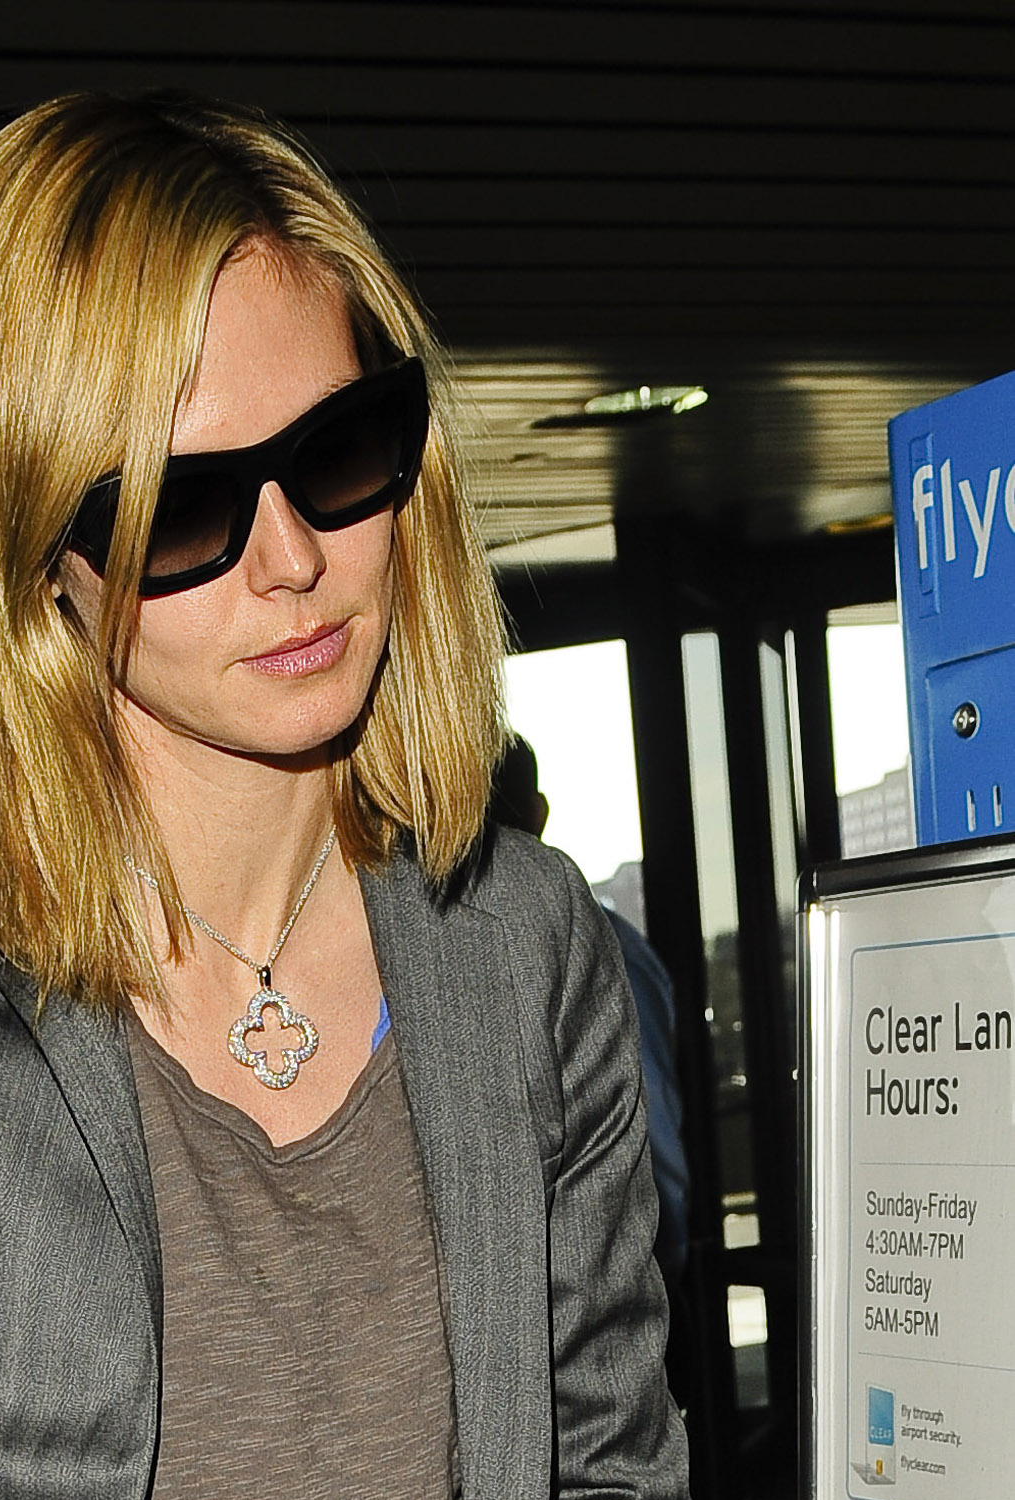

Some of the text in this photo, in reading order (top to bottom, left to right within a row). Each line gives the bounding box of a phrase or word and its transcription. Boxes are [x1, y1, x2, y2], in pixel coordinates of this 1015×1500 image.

[866, 1005, 942, 1055] Clear
[866, 1068, 958, 1115] Hours:
[866, 1190, 977, 1226] Sunday-Friday
[865, 1229, 964, 1259] 4:30AM-7PM
[865, 1267, 932, 1303] Saturday
[864, 1306, 939, 1337] 5AM-5PM
[913, 1407, 944, 1425] through
[901, 1424, 927, 1440] airport
[900, 1455, 946, 1475] flyclear.com
